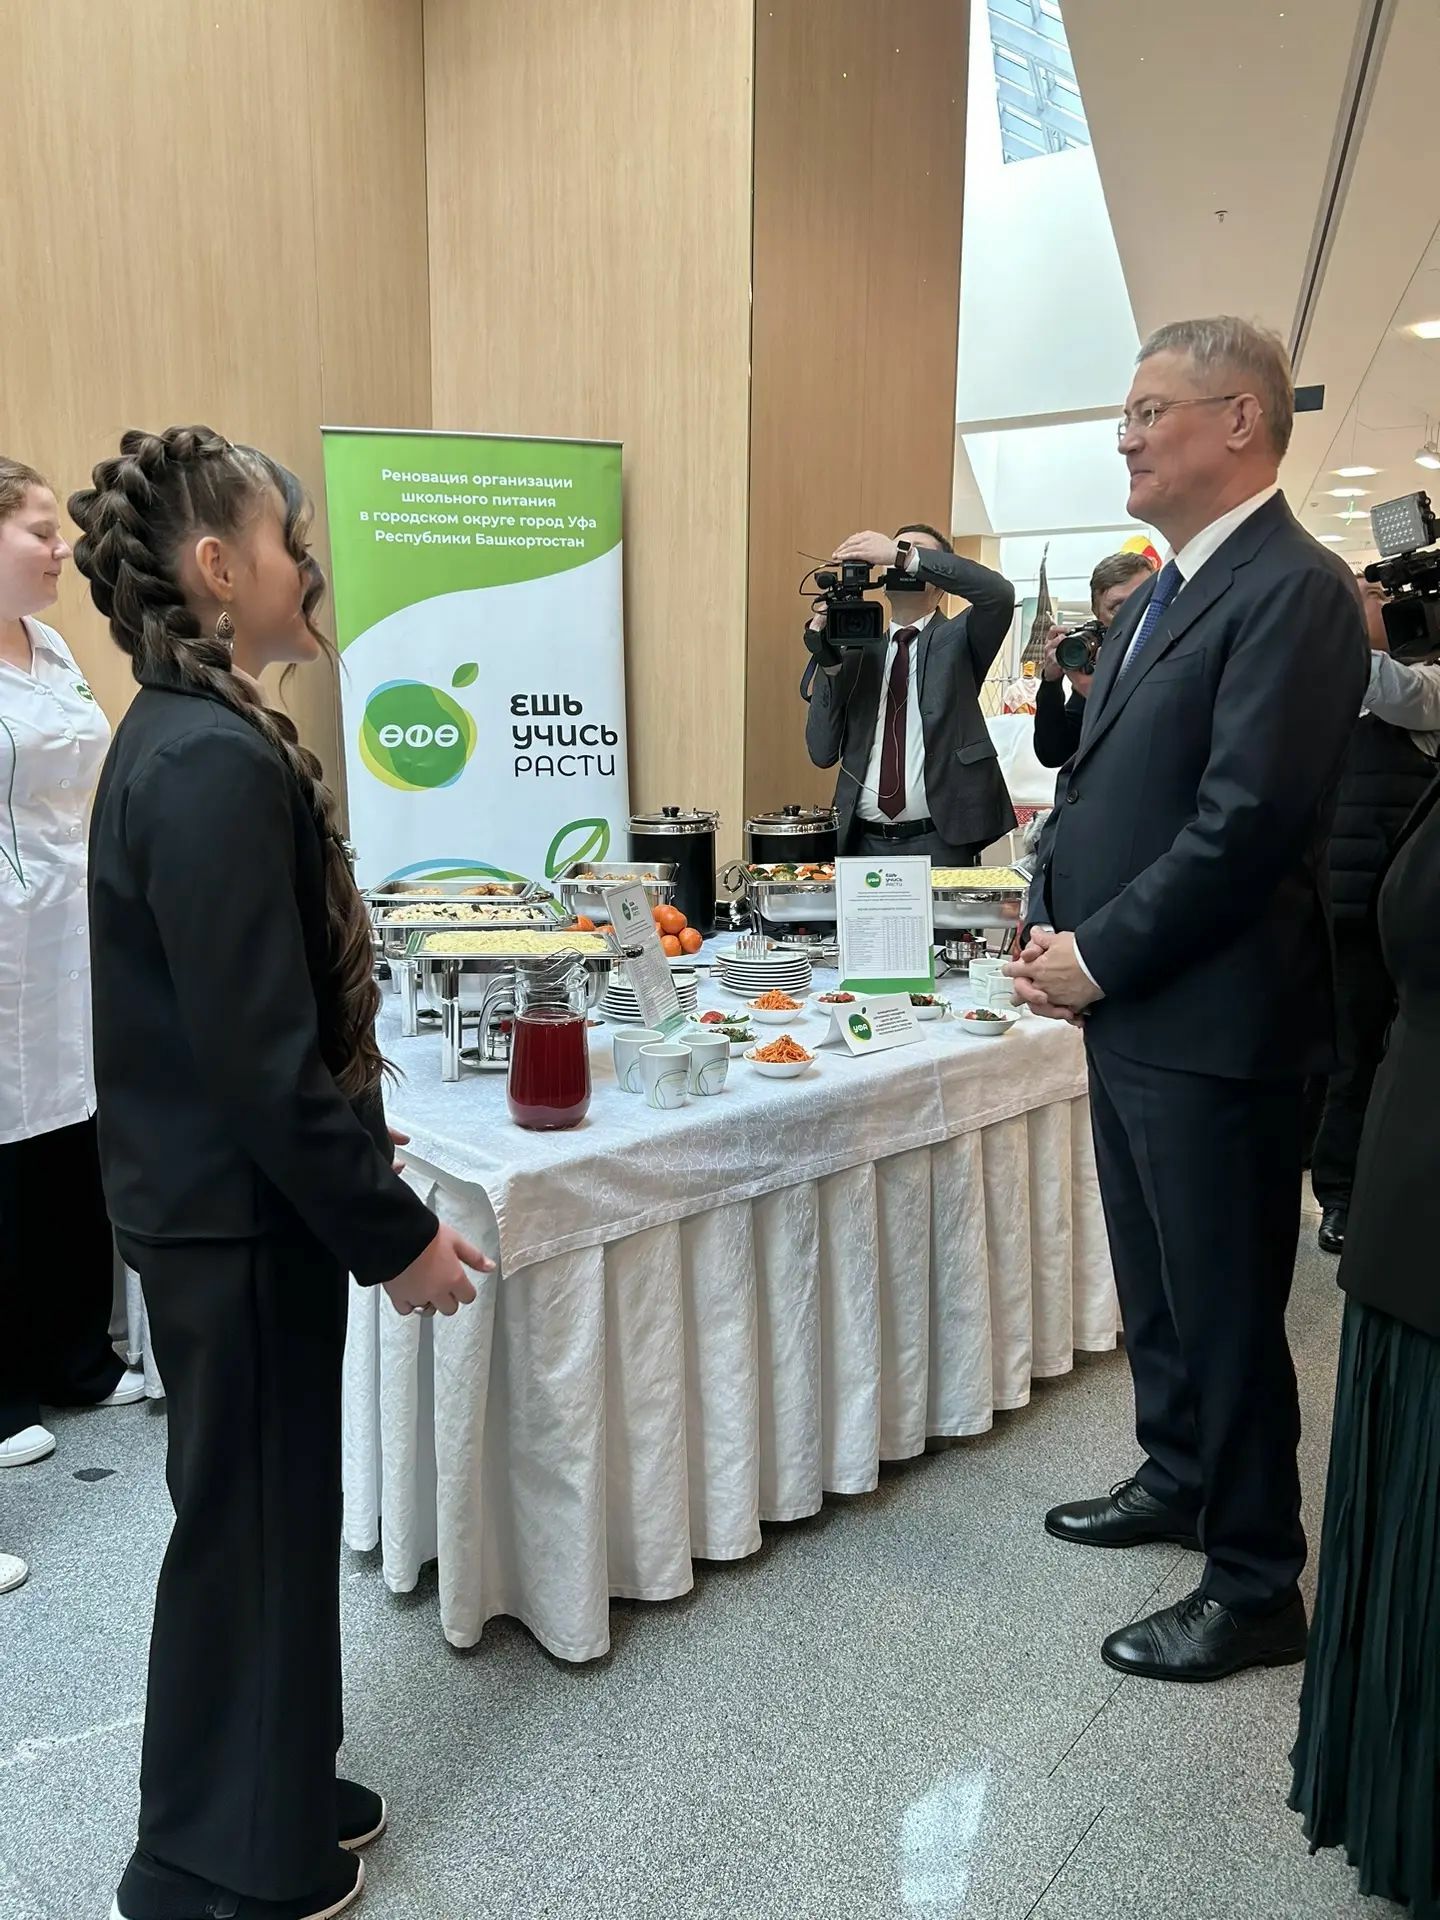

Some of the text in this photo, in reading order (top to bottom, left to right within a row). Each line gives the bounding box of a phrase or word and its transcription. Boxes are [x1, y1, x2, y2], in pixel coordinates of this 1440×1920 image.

[381, 468, 573, 489] Реновация организации
[401, 491, 556, 507] школьного питания
[359, 511, 597, 530] в городском округе город Уфа
[375, 530, 585, 549] Республики Башкортостан
[514, 754, 616, 777] РАСТИ
